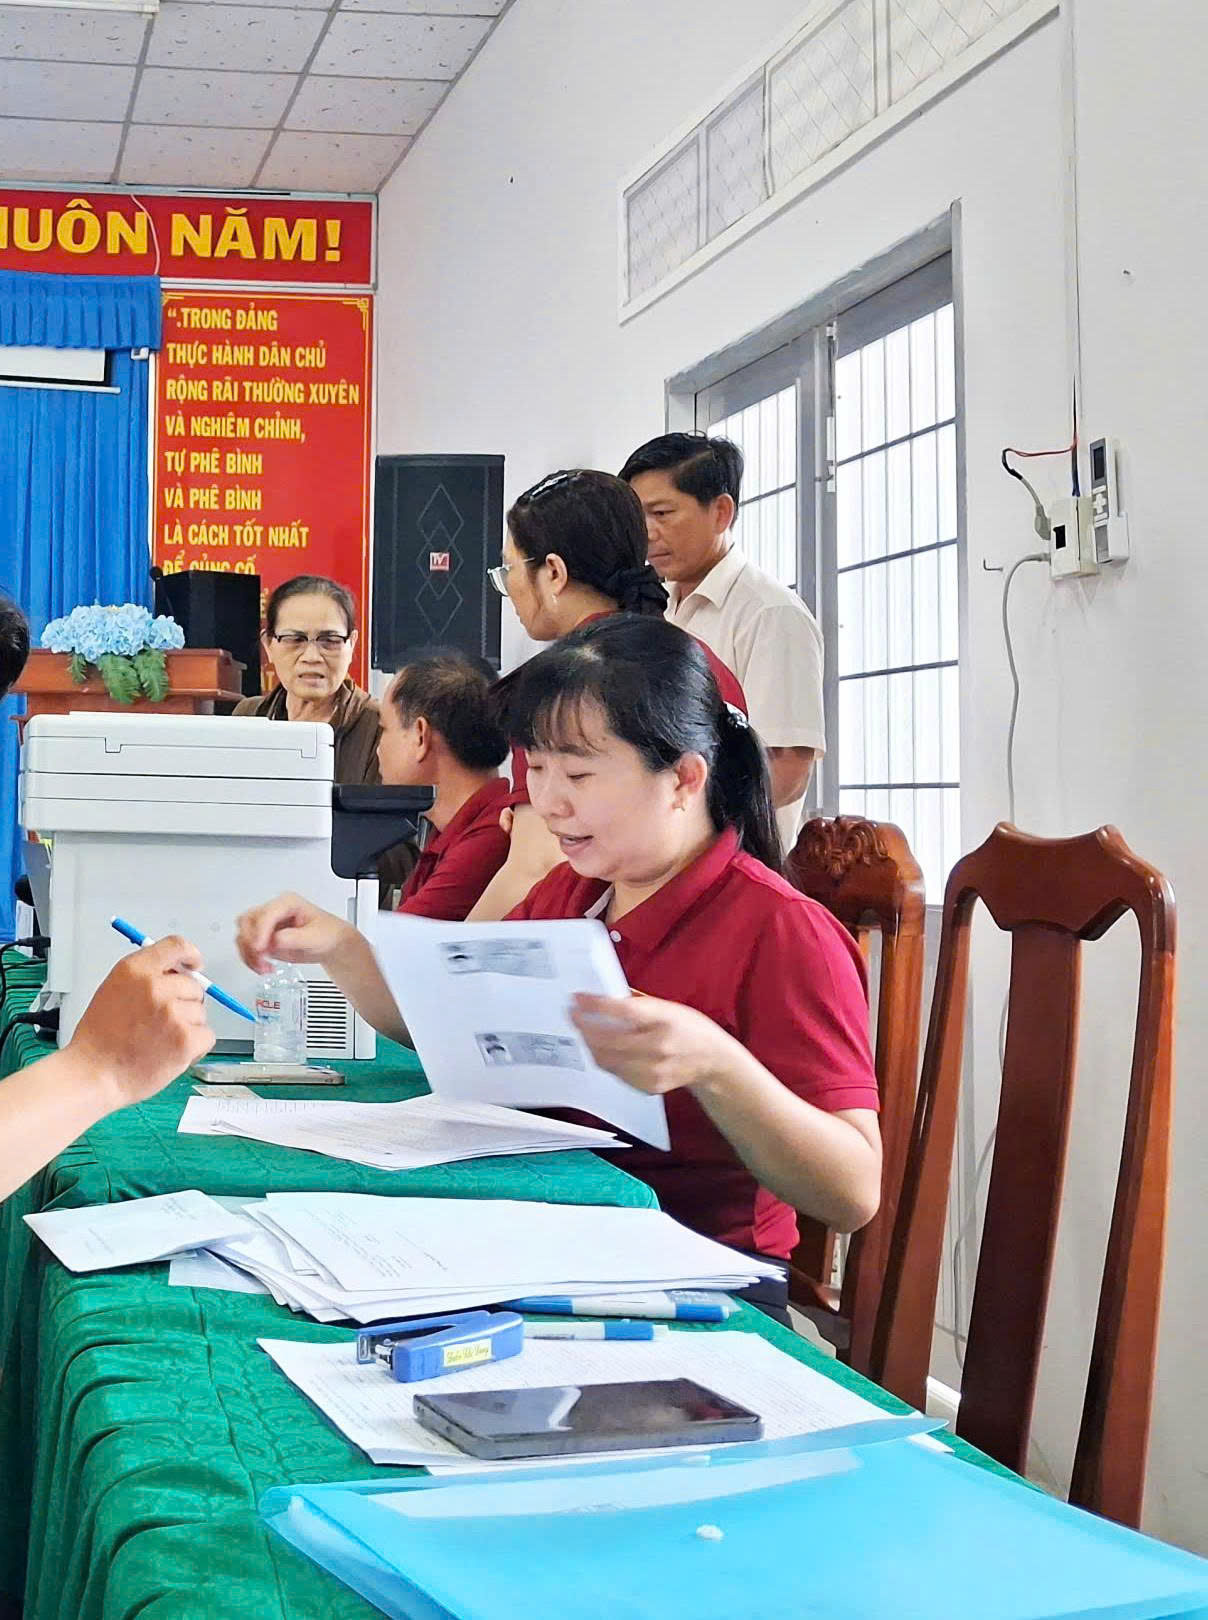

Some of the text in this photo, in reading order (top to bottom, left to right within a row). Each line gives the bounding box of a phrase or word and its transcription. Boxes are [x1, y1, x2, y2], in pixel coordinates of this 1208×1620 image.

[172, 208, 340, 261] NĂM!
[236, 302, 277, 330] ĐẢNG
[167, 340, 325, 368] THỰC HÀNH DÂN CHỦ
[166, 375, 208, 404] RỘNG
[243, 377, 304, 403] THƯỜNG
[309, 379, 359, 404] XUYÊN
[166, 411, 305, 443] VÀ NGHIÊM CHỈNH,
[164, 448, 262, 476] TỰ PHÊ BÌNH
[165, 483, 261, 510] VÀ PHÊ BÌNH
[164, 518, 309, 547] LÀ CÁCH TỐT NHẤT
